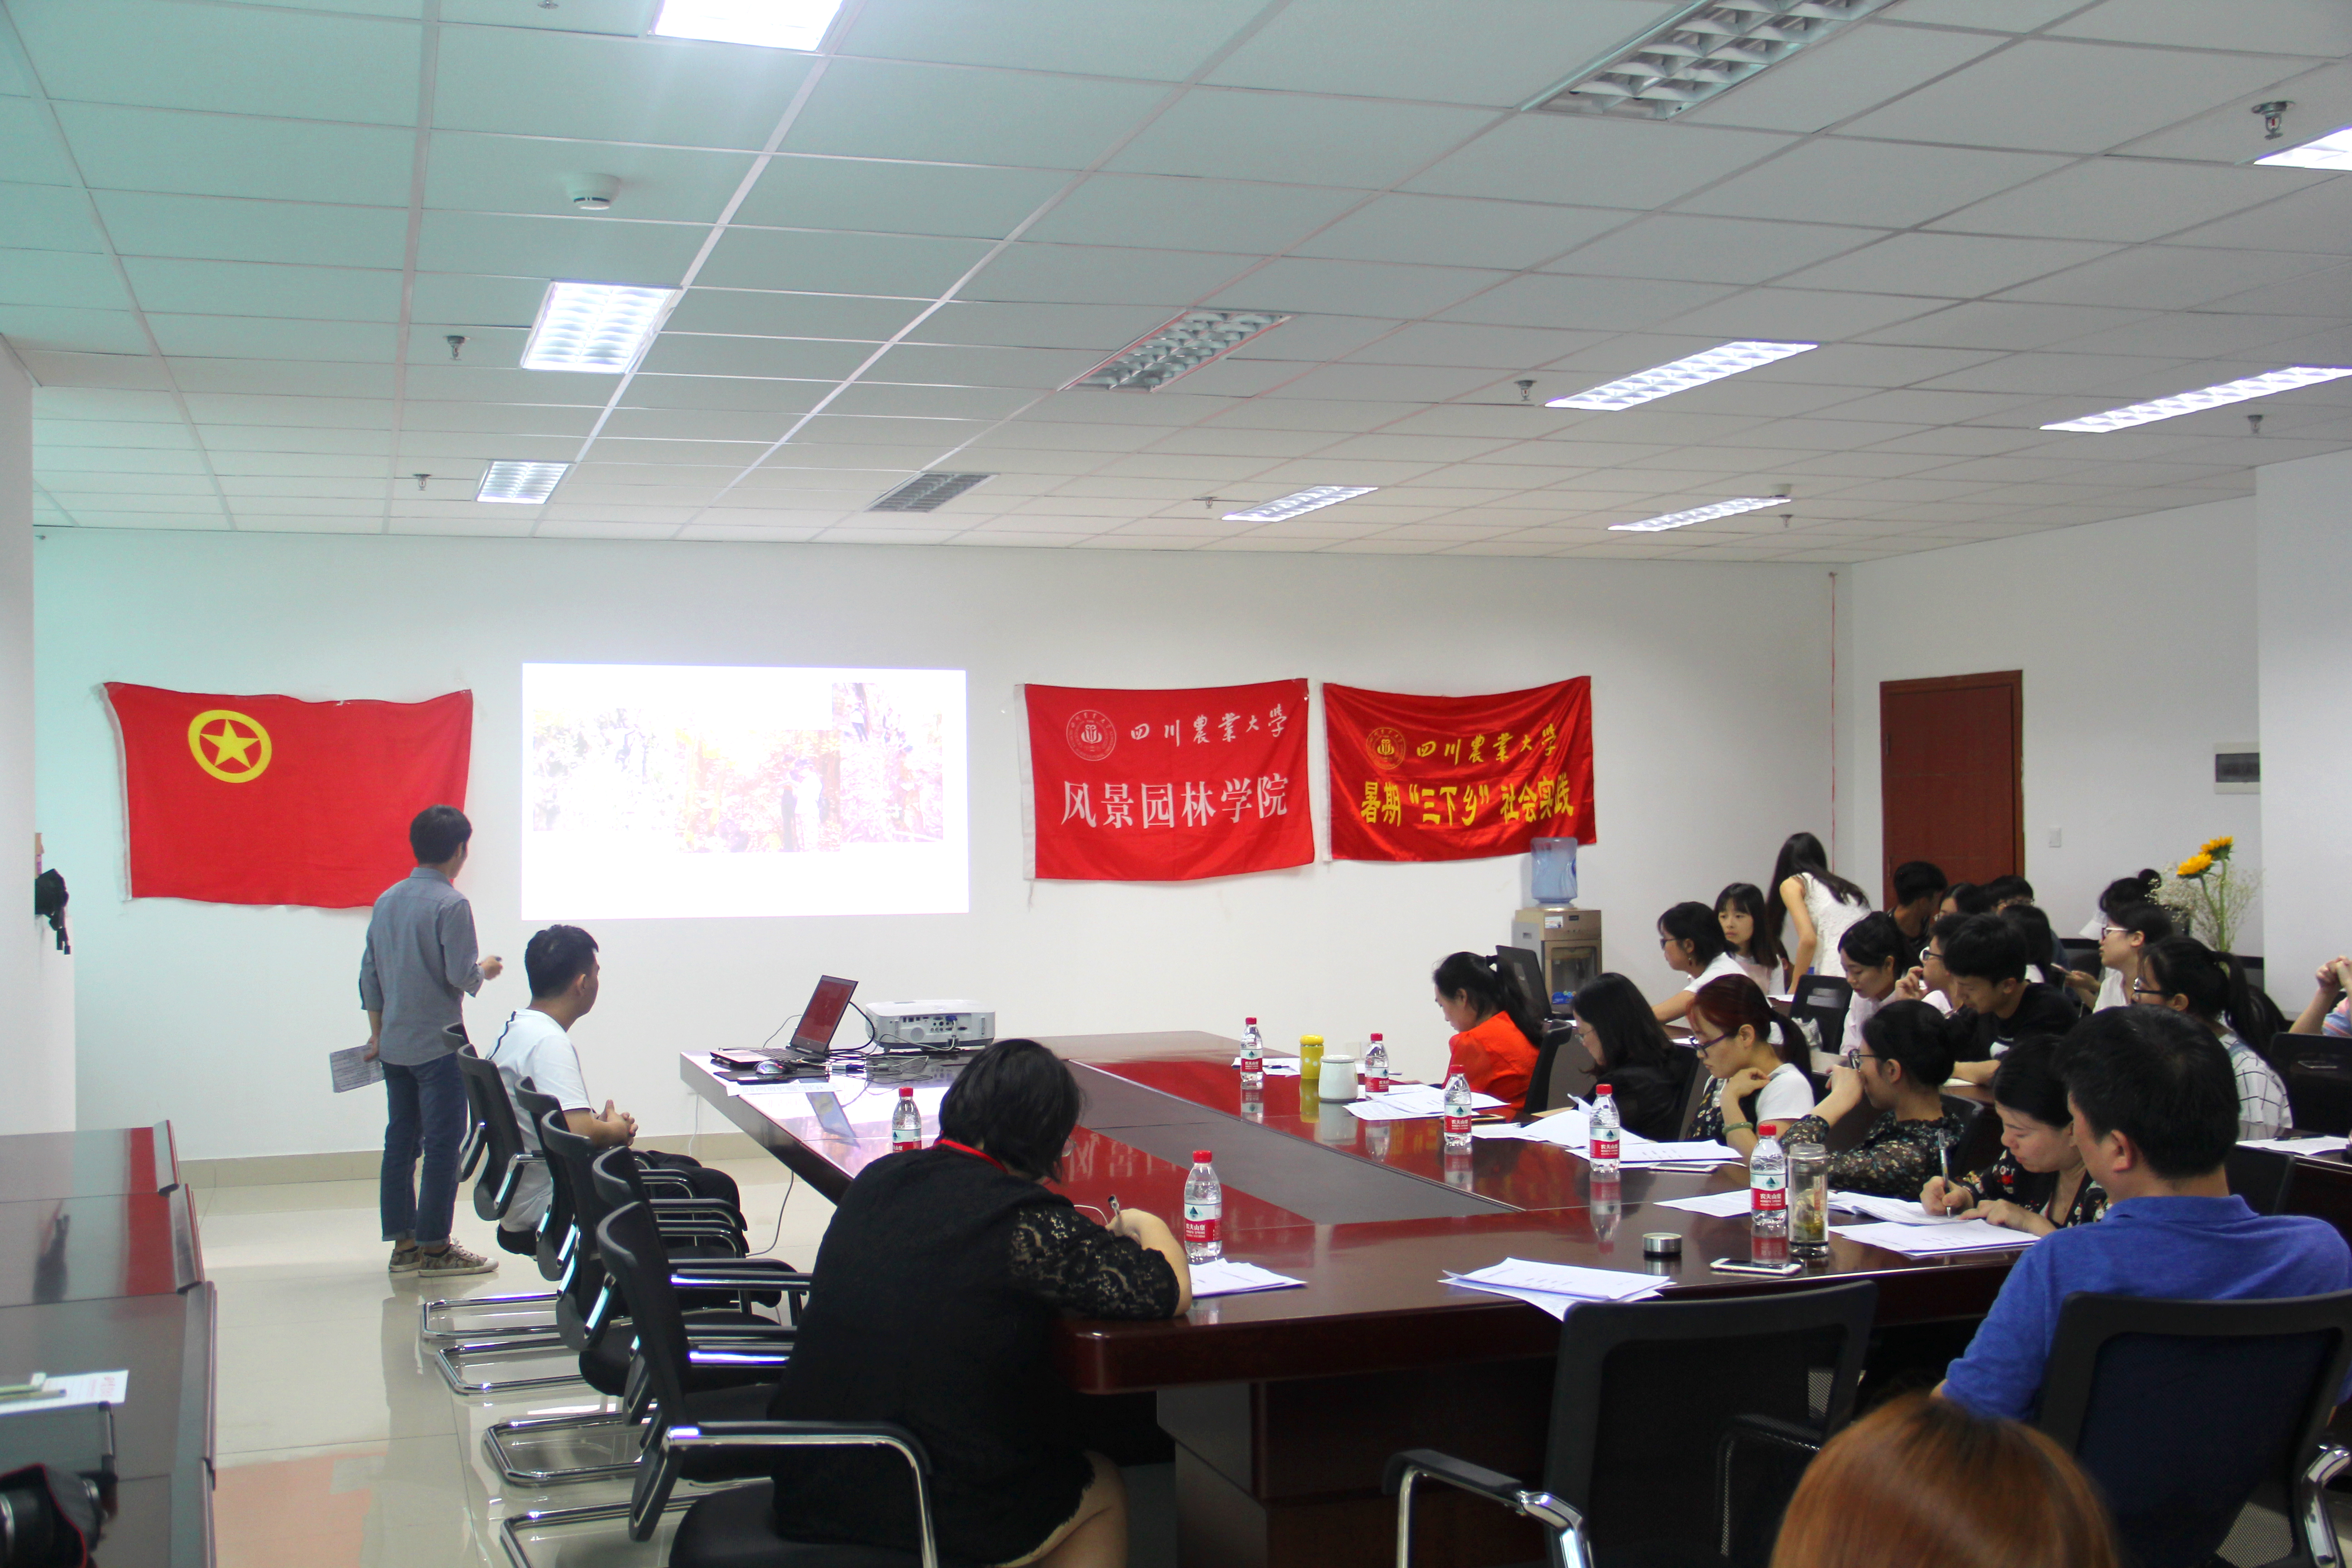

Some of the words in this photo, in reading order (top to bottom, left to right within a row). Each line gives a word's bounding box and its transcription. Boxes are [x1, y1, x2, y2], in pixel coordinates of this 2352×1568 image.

[1060, 773, 1288, 829] 风景园林学院
